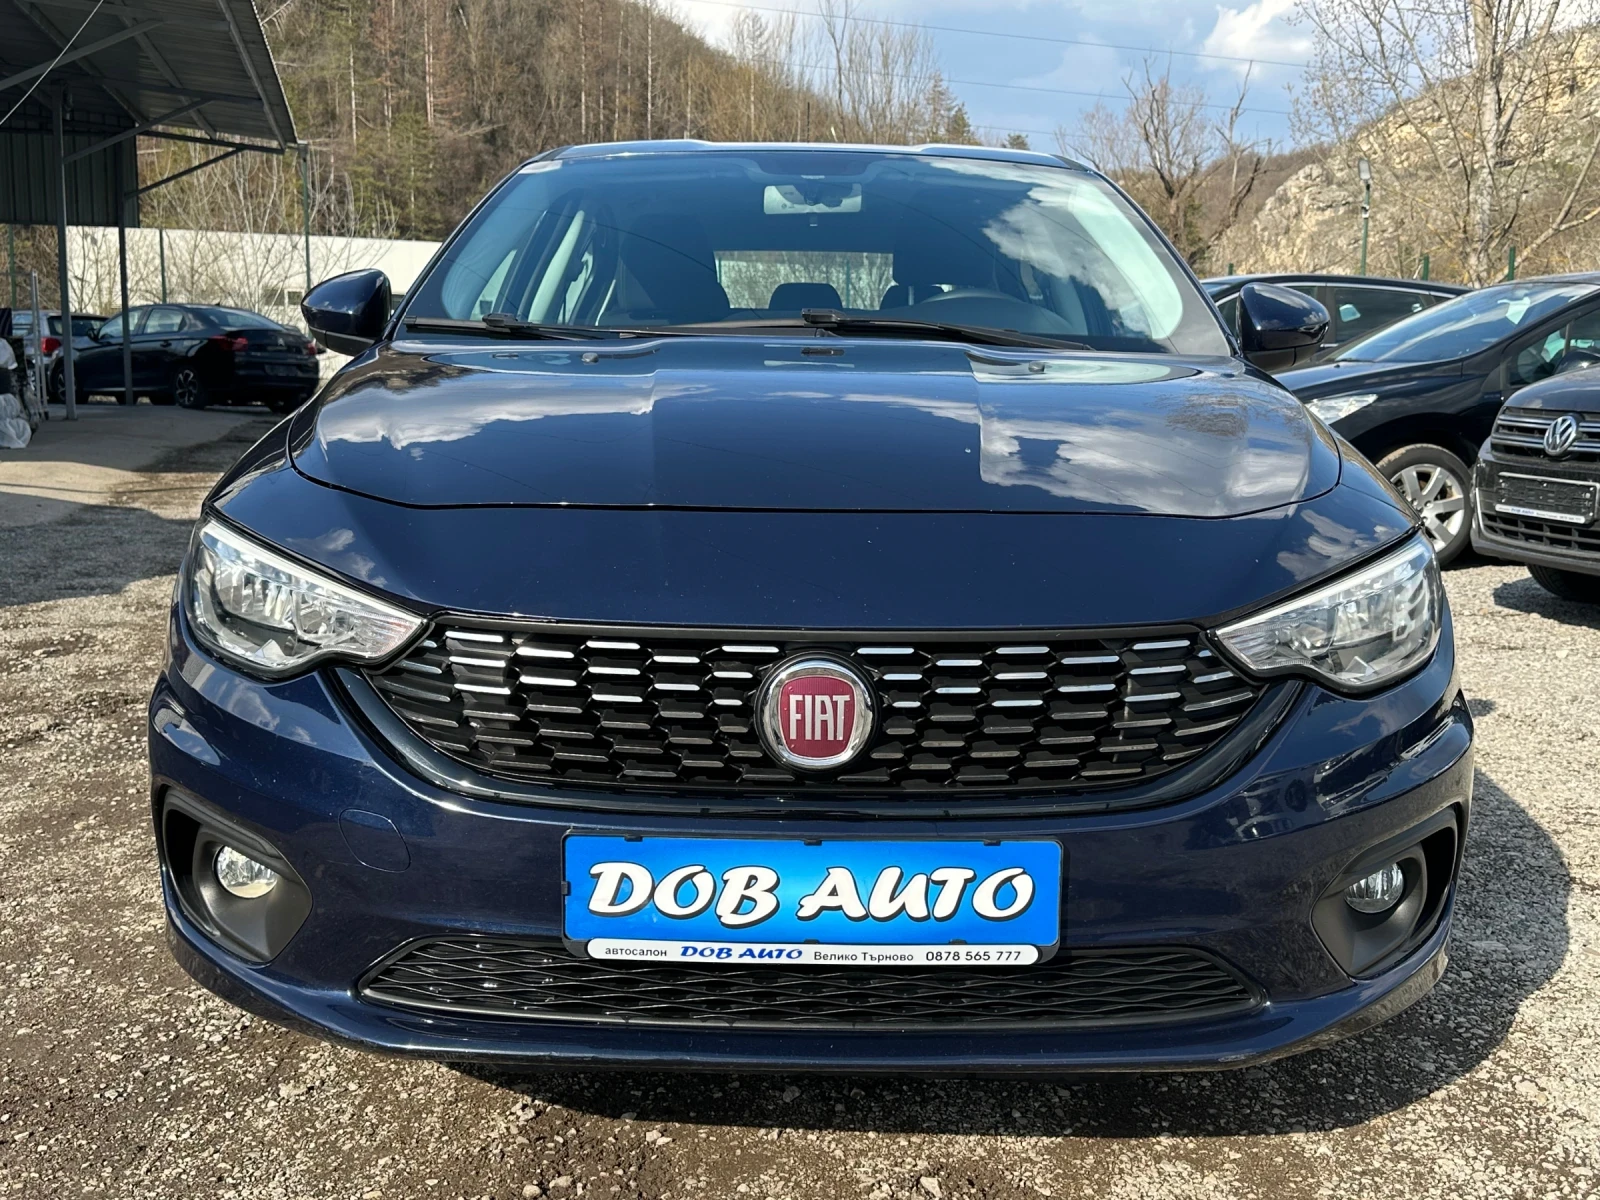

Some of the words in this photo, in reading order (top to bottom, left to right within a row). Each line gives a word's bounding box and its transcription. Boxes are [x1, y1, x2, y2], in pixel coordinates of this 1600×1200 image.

[789, 695, 850, 740] FIAT
[588, 861, 780, 929] DOB
[795, 866, 1036, 922] AUTO
[605, 946, 667, 958] автосалон
[680, 946, 732, 959] DOB
[738, 948, 803, 959] AUTO
[814, 951, 857, 961] Велико
[861, 952, 914, 963] Търново
[926, 951, 960, 961] 0878
[965, 951, 991, 961] 565
[996, 951, 1021, 961] 777
